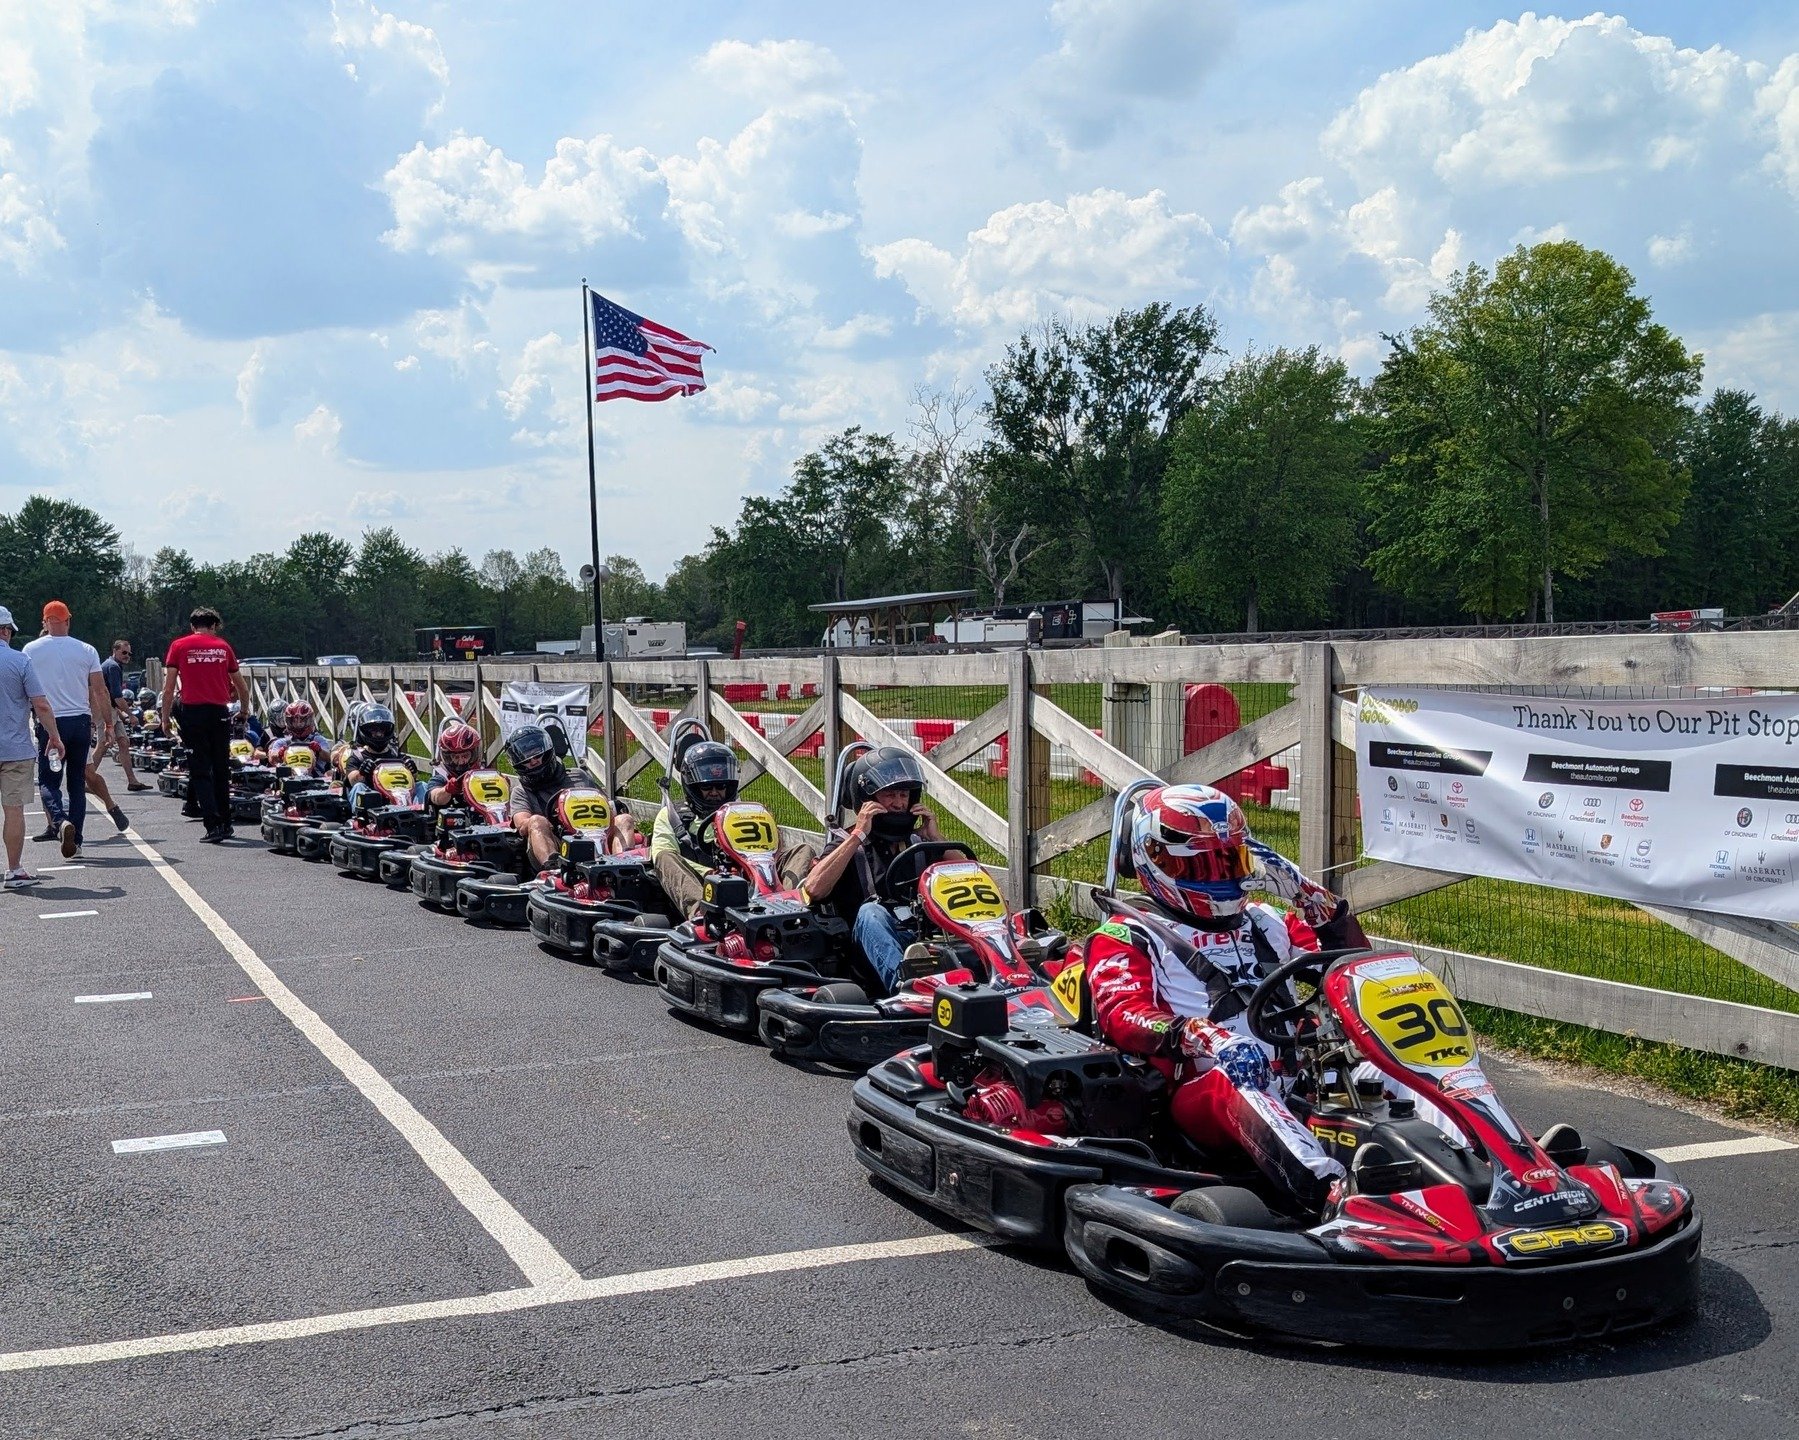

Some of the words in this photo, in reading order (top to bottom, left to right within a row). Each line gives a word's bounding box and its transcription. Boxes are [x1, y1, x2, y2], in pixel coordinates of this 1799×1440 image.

[1513, 704, 1577, 730] Thank
[1579, 708, 1623, 731] You
[1627, 712, 1650, 732] to
[1656, 709, 1702, 734] Our
[1706, 709, 1741, 735] Pit
[1747, 709, 1799, 745] Stop
[1386, 748, 1413, 757] Beechmont
[1414, 750, 1442, 759] Automotive
[287, 754, 312, 765] 32
[1551, 761, 1584, 771] Beechmont
[1585, 764, 1620, 773] Automotive
[1621, 766, 1640, 775] Group
[388, 772, 409, 785] 3
[1570, 773, 1618, 782] theautomile.com
[1744, 772, 1783, 783] Beechmont
[481, 782, 503, 799] 5
[571, 804, 607, 820] 29
[1621, 813, 1649, 822] Beechmont
[1569, 815, 1594, 823] Cincinnati
[1624, 820, 1644, 828] TOYOTA
[1399, 821, 1427, 831] MASERATI
[732, 821, 773, 844] 31
[1731, 831, 1758, 839] CINCINNATI
[1786, 828, 1799, 836] Audi
[1771, 834, 1797, 843] Cincinnati
[1546, 842, 1578, 853] MASERATI
[1601, 858, 1615, 867] Village
[1714, 871, 1725, 879] East
[1740, 865, 1786, 877] MASERATI
[1753, 876, 1782, 884] CINCINNATI
[940, 884, 1001, 911] 26
[940, 1004, 950, 1020] 30
[1377, 998, 1468, 1050] 30
[1513, 1189, 1587, 1213] CENTURION
[1568, 1197, 1589, 1206] LINE
[1509, 1222, 1617, 1254] CRG
